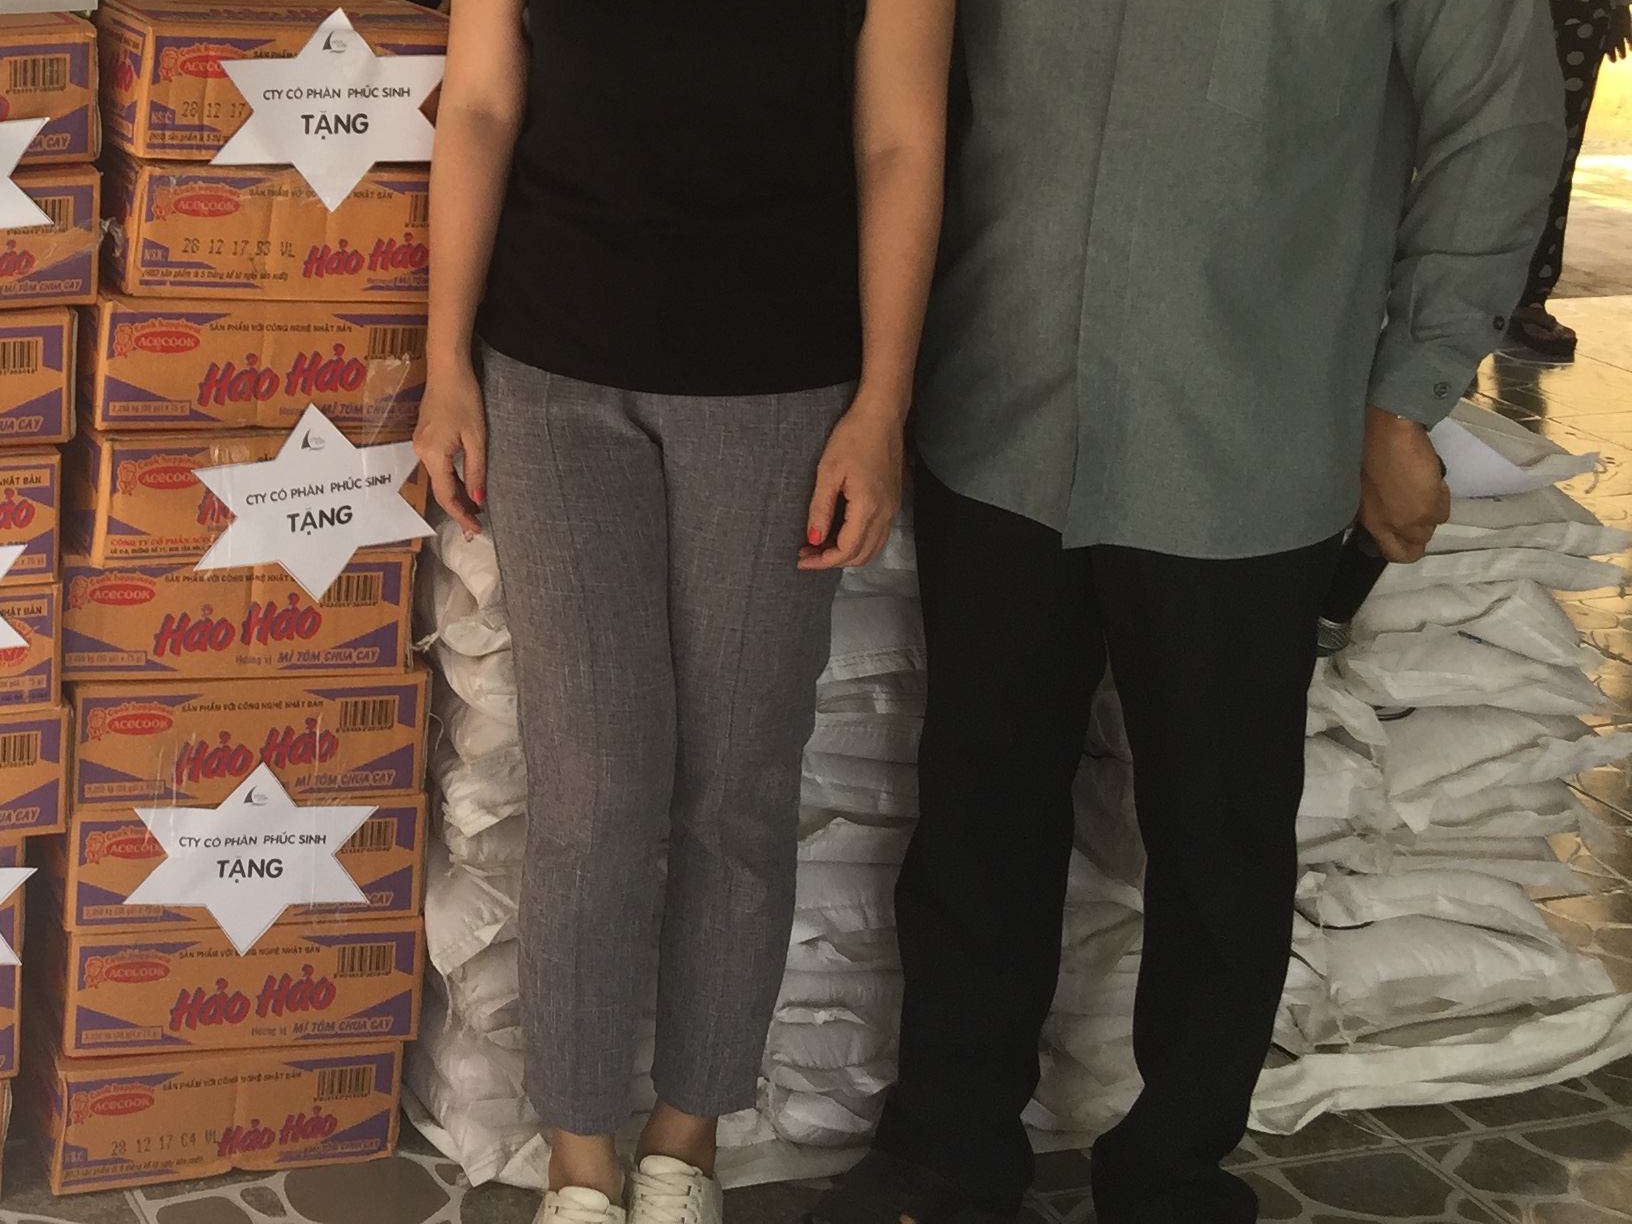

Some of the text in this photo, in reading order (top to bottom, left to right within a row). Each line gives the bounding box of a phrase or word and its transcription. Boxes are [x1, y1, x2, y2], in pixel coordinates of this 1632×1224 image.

[263, 89, 283, 100] CTY
[348, 84, 379, 99] PHÚC
[382, 87, 410, 99] SINH
[301, 110, 369, 140] TẶNG
[304, 239, 365, 278] Hảo
[198, 343, 366, 407] Hảo Hảo
[246, 492, 267, 506] CTY
[330, 478, 362, 493] PHÚC
[366, 474, 391, 488] SINH
[287, 505, 353, 536] TẶNG
[153, 593, 322, 657] Hảo Hảo
[176, 718, 339, 784] Hảo Hảo
[179, 836, 201, 848] CTY
[263, 831, 296, 845] PHÚC
[299, 834, 326, 845] SINH
[217, 855, 283, 883] TẶNG
[170, 964, 336, 1031] Hảo Hảo
[137, 1138, 151, 1153] 12
[217, 1106, 337, 1157] Hảo Hảo
